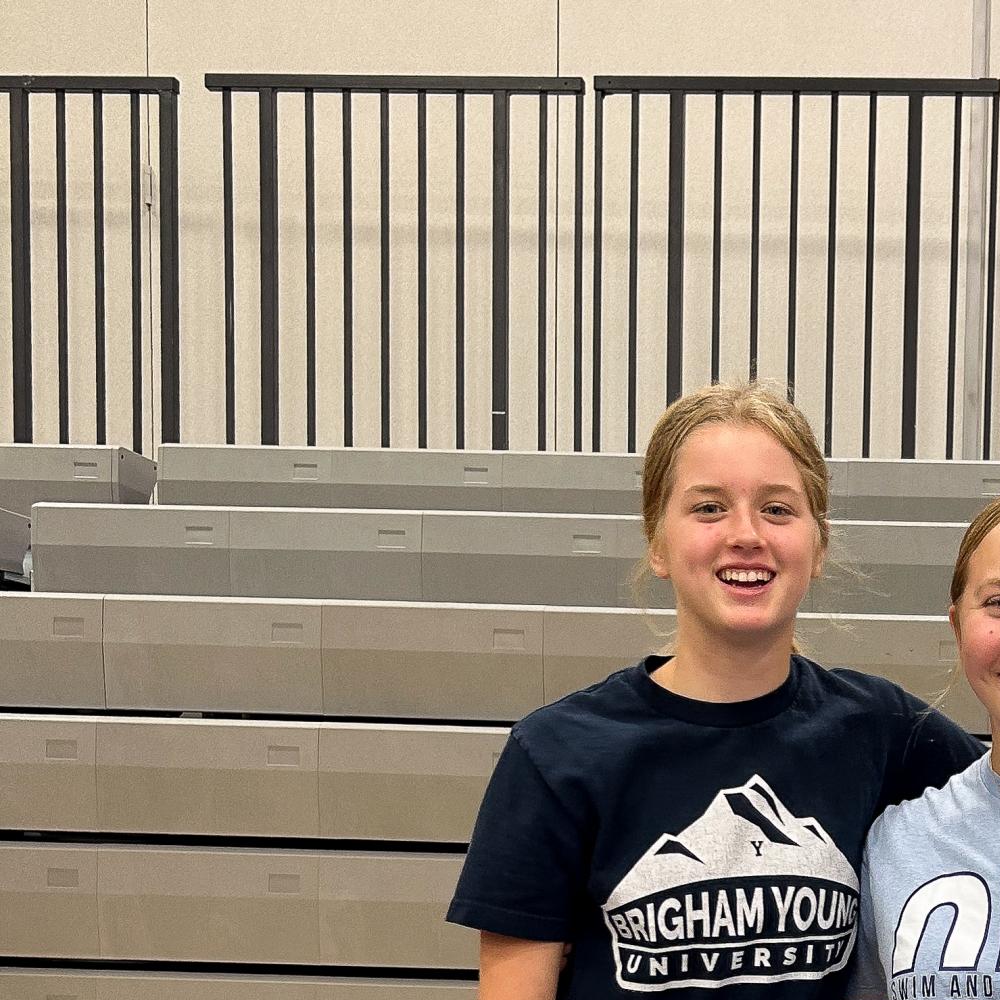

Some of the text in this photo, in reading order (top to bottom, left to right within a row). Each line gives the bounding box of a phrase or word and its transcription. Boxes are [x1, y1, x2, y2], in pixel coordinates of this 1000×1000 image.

[750, 841, 763, 856] Y
[611, 885, 858, 943] BRIGHAM YOUNG
[626, 939, 845, 977] UNIVERSITY
[949, 974, 993, 998] AND
